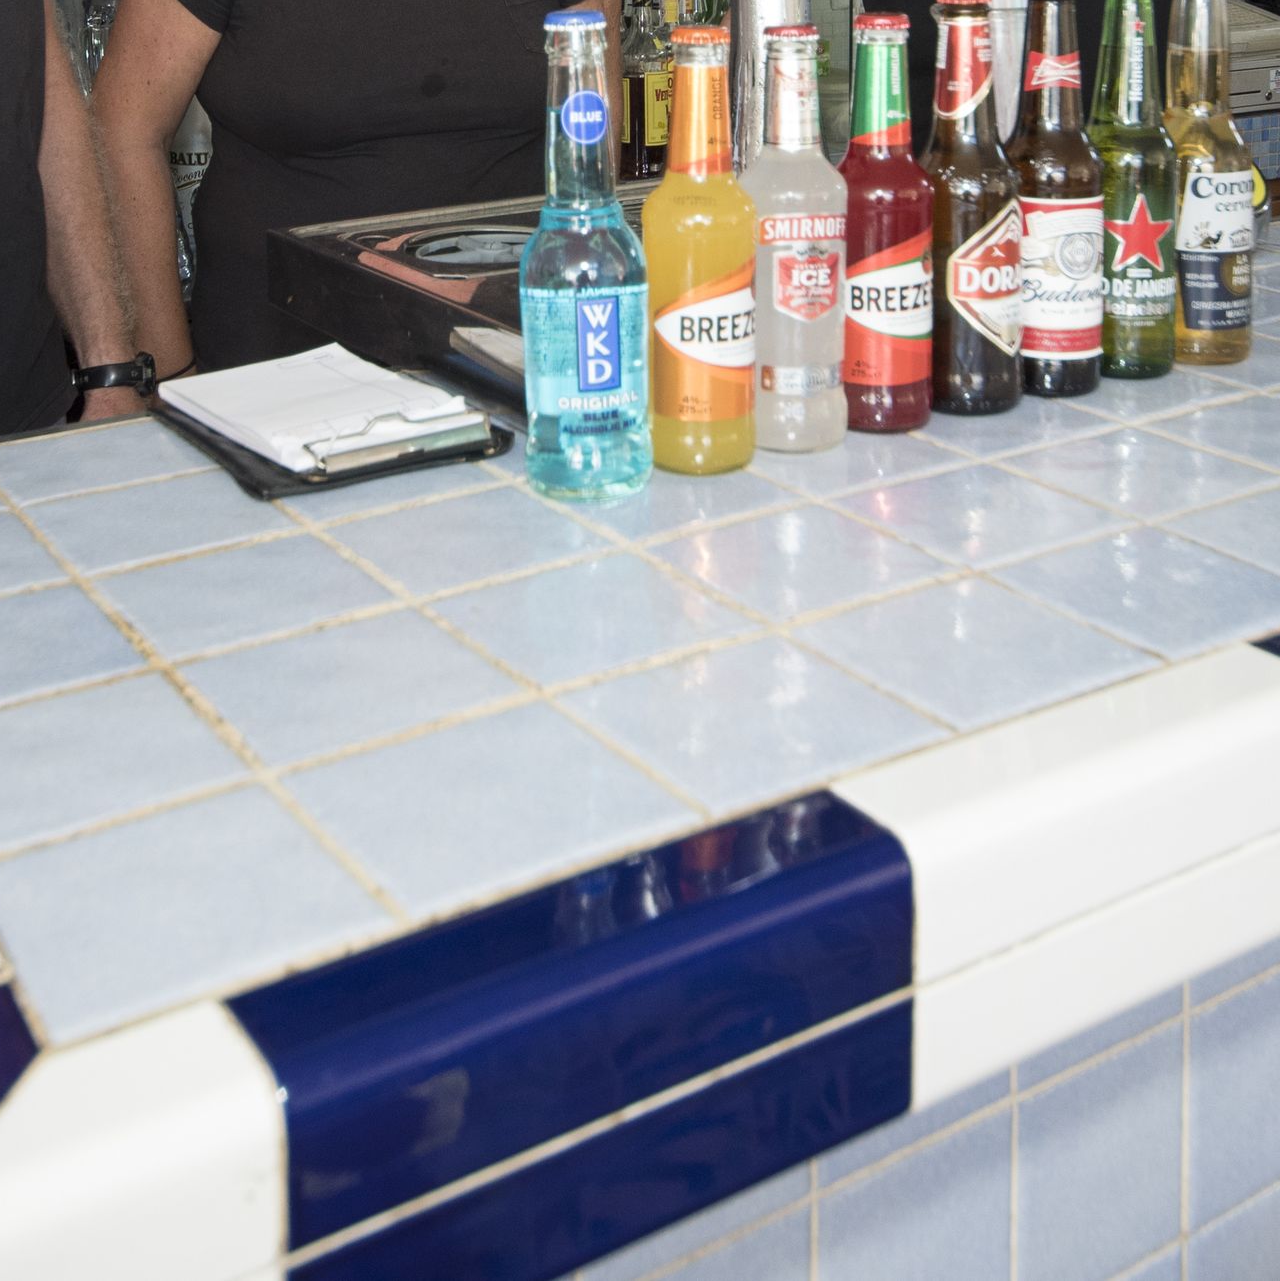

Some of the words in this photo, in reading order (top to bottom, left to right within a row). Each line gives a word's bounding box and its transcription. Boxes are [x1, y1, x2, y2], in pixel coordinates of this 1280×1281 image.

[1129, 36, 1143, 102] Heineken
[712, 75, 722, 121] ORANGE
[570, 111, 603, 123] BLUE
[1191, 175, 1254, 199] Coron
[790, 268, 831, 288] ICE
[1112, 278, 1132, 297] DE
[558, 390, 639, 410] ORIGINAL
[582, 409, 619, 423] BLUE
